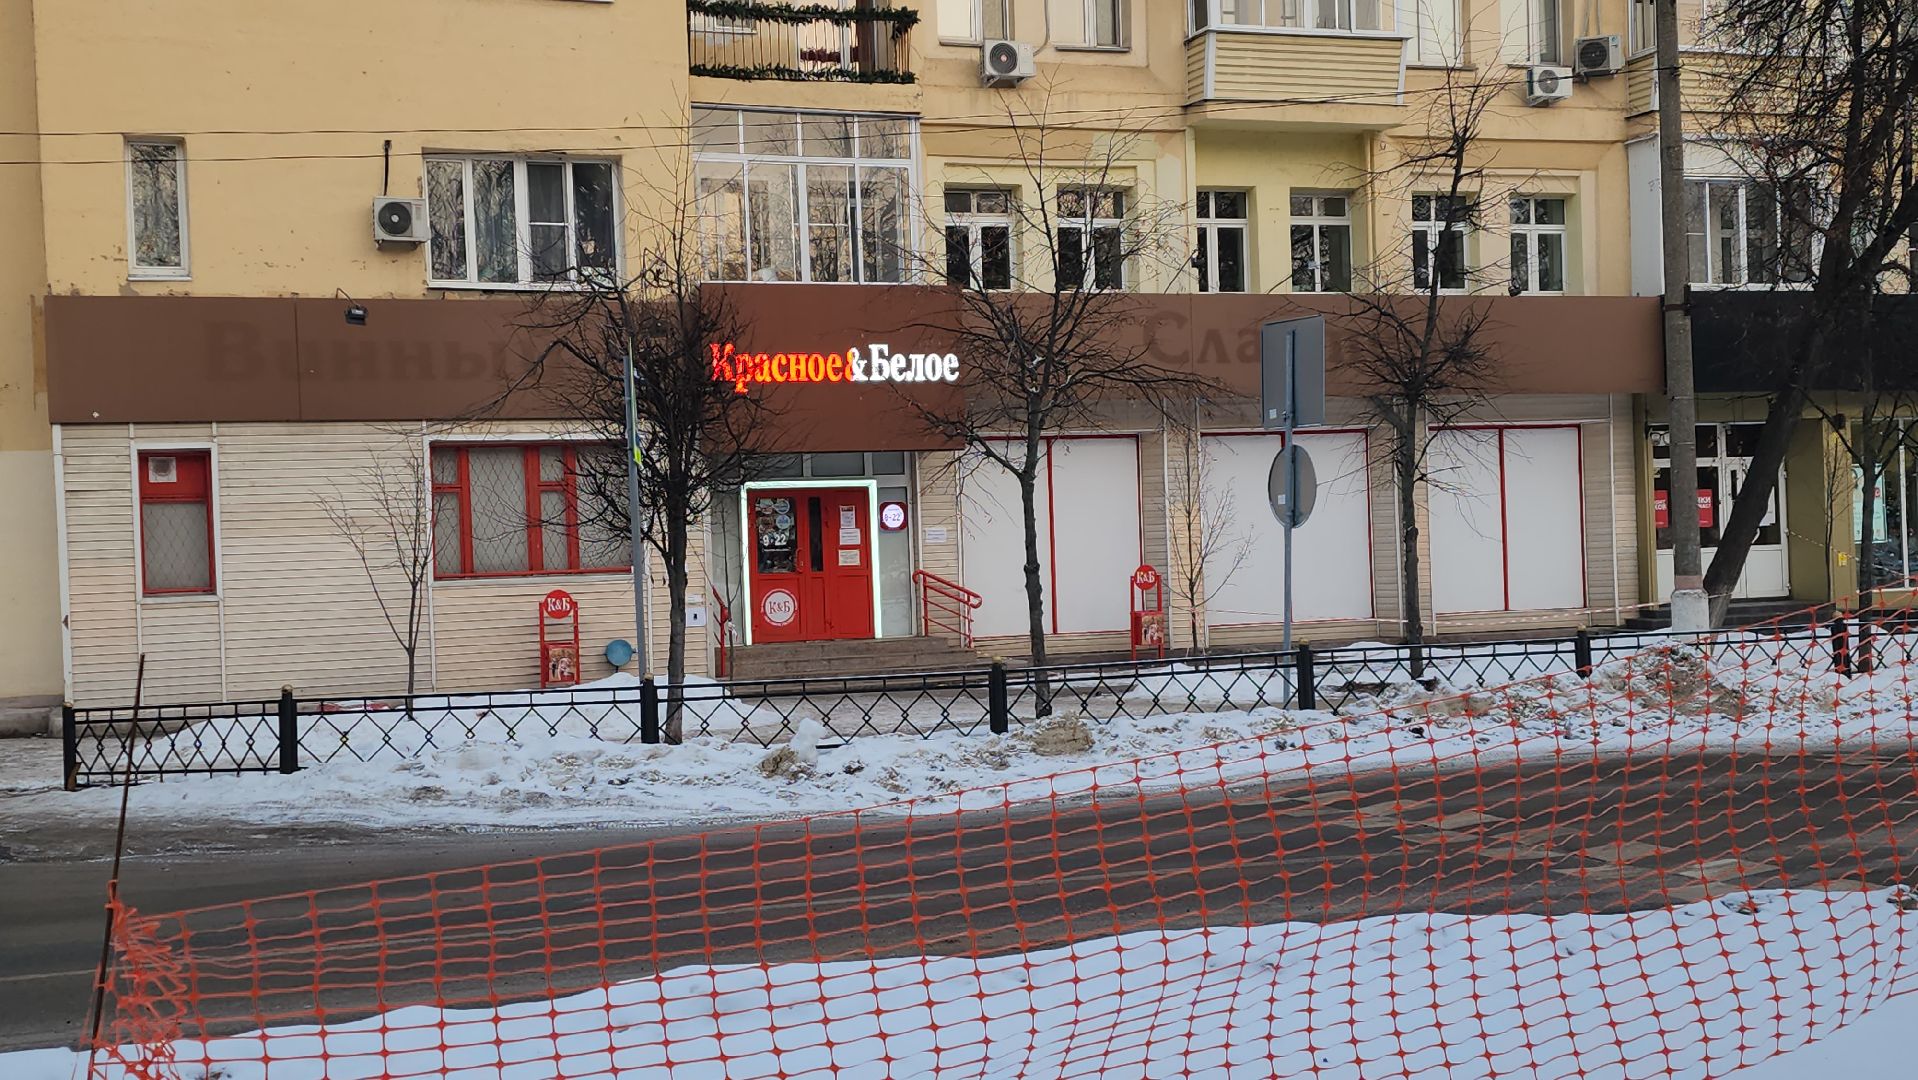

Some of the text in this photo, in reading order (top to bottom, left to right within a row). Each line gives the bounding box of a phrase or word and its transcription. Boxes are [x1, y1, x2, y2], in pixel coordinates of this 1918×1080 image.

[709, 343, 959, 394] Красное&Белое
[547, 597, 570, 612] К&Б
[769, 601, 790, 614] К&Б
